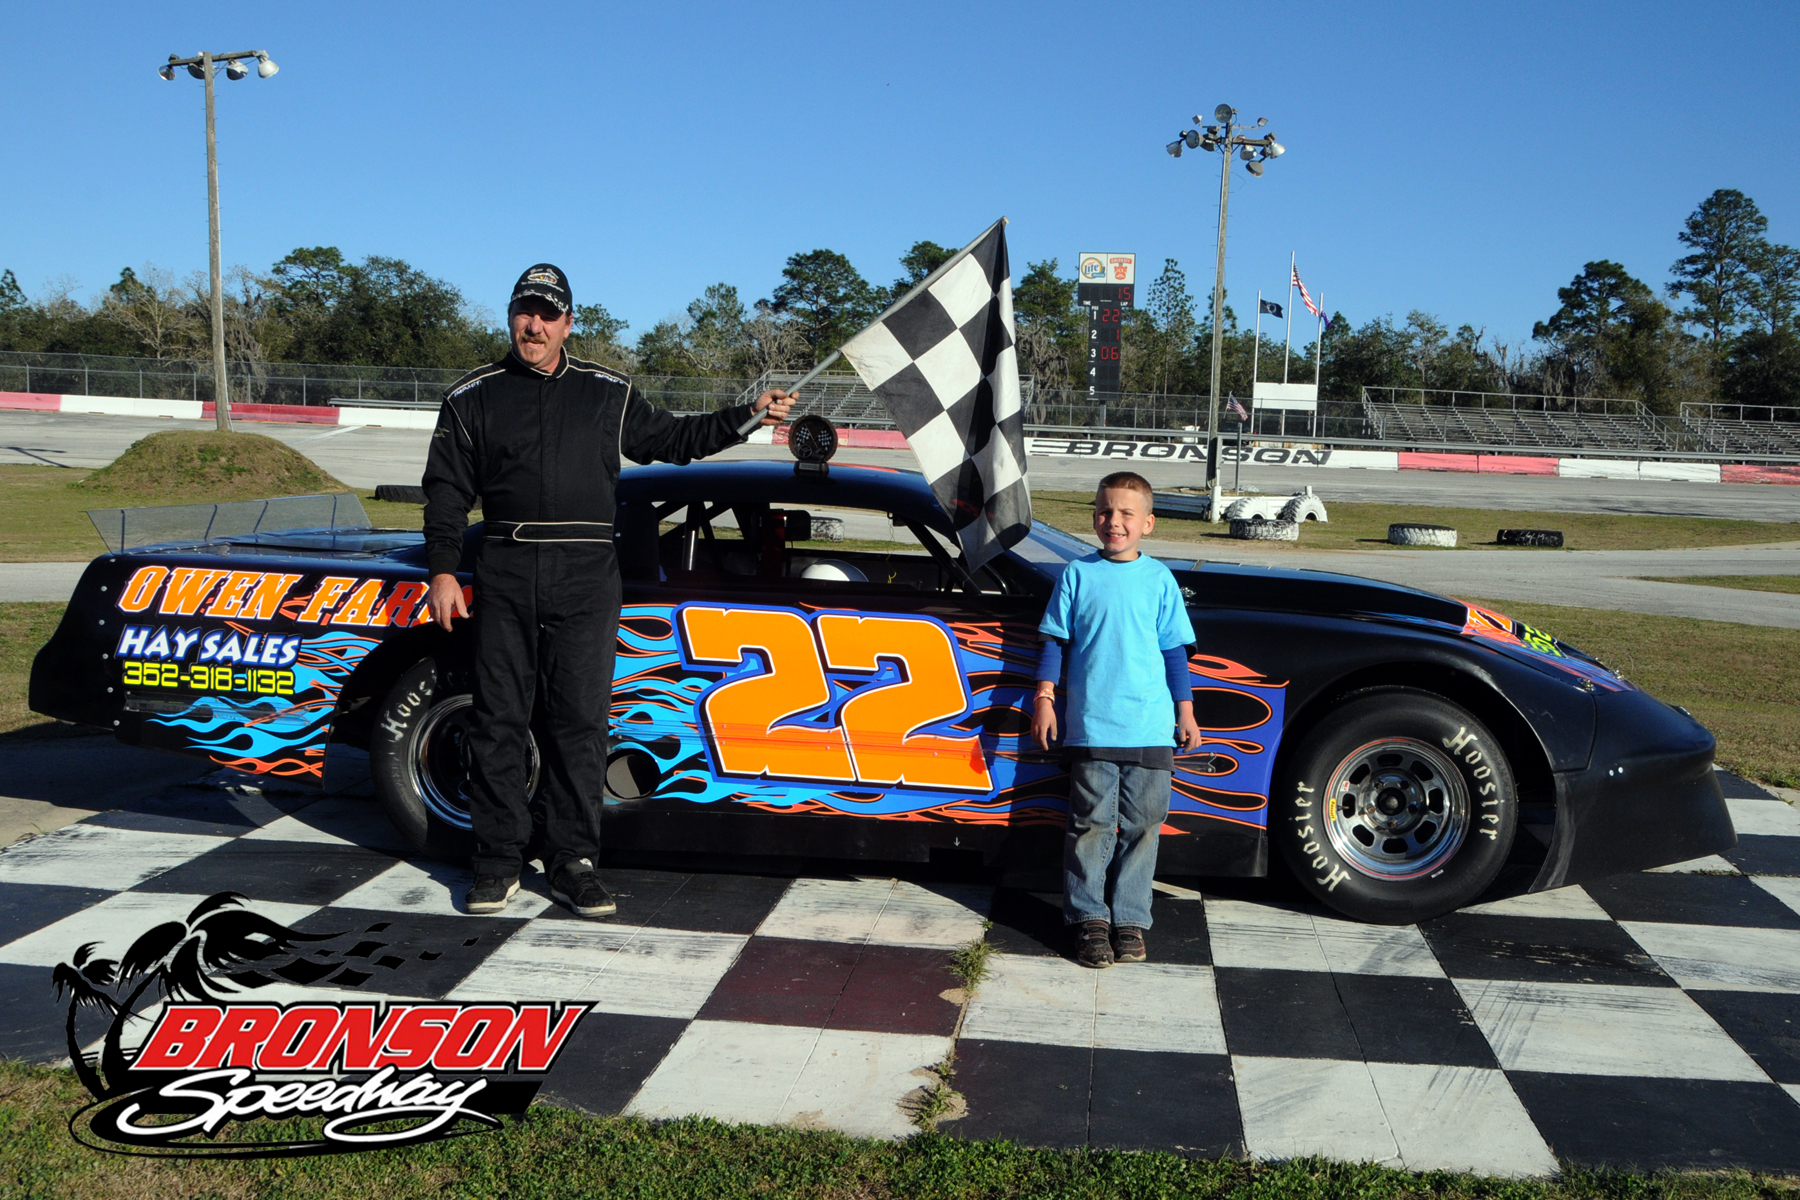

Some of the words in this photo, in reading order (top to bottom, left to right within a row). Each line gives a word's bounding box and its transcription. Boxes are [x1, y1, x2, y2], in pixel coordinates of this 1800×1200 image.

[1118, 287, 1132, 300] 15
[1093, 310, 1097, 320] 1
[1102, 309, 1121, 323] 22
[1091, 330, 1097, 339] 2
[1090, 348, 1096, 358] 3
[1101, 346, 1119, 360] 06
[1089, 367, 1096, 377] 4
[1089, 386, 1095, 395] 5
[1063, 438, 1333, 466] BRONSON
[115, 564, 304, 622] OWEN
[116, 624, 199, 661] HAY
[199, 630, 302, 667] SALES
[122, 660, 295, 696] 352-318-1132
[680, 605, 995, 793] 22
[1442, 726, 1505, 842] Hoosier
[1295, 781, 1351, 892] Hoosier
